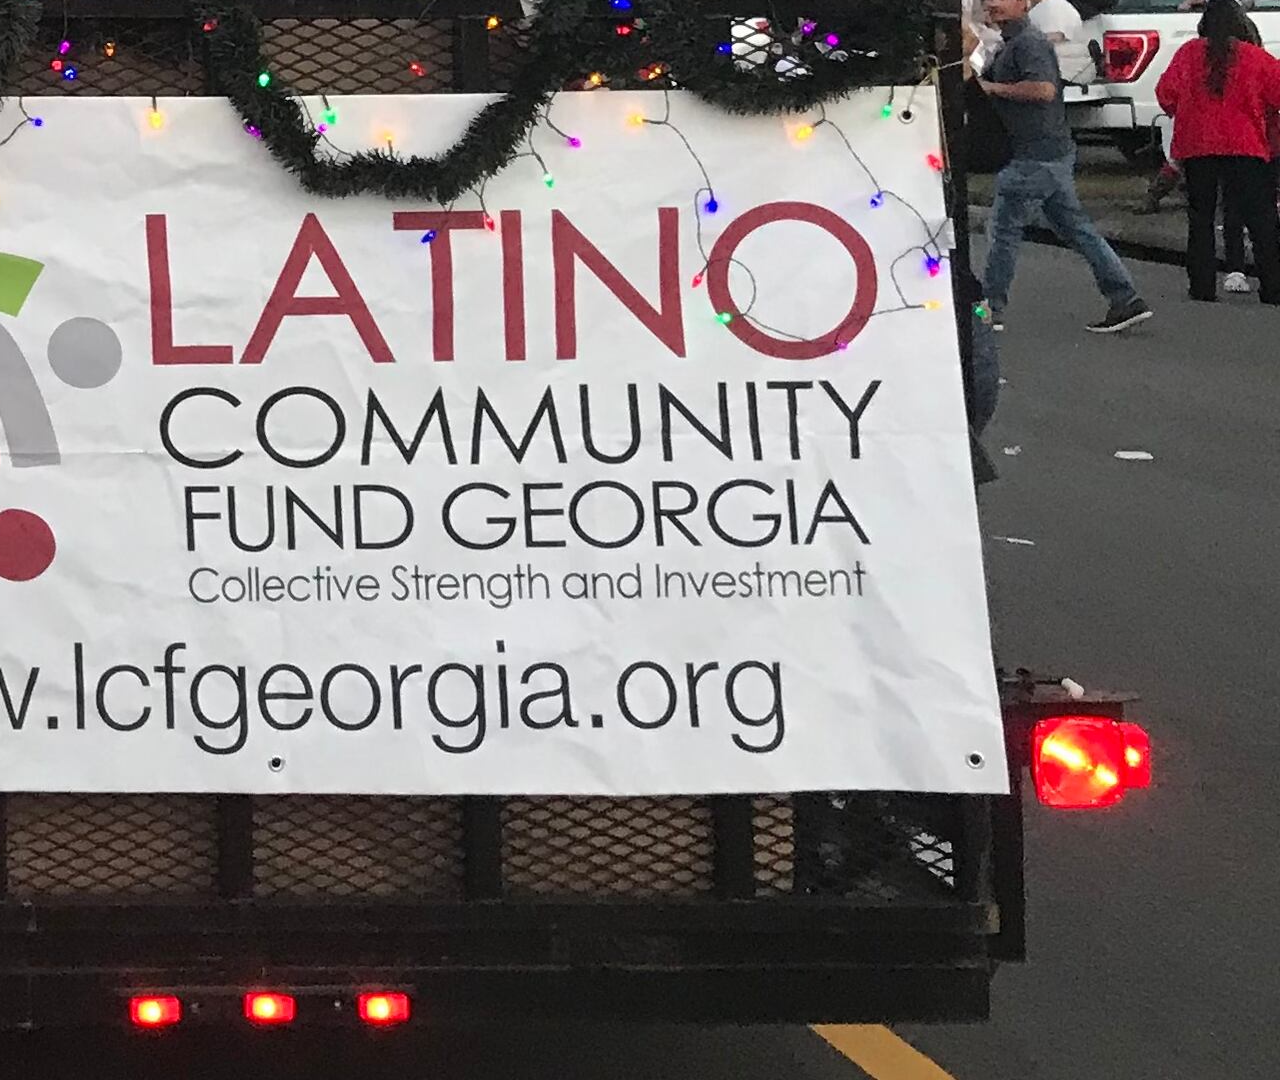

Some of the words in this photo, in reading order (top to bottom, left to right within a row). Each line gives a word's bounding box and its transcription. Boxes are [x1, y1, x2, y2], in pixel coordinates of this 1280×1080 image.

[145, 200, 879, 365] LATINO
[159, 379, 882, 469] COMMUNITY
[185, 484, 414, 553] FUND
[442, 478, 871, 550] GEORGIA
[188, 566, 381, 604] Collective
[391, 565, 551, 609] Strength
[562, 563, 643, 601] and
[655, 562, 867, 599] Investment
